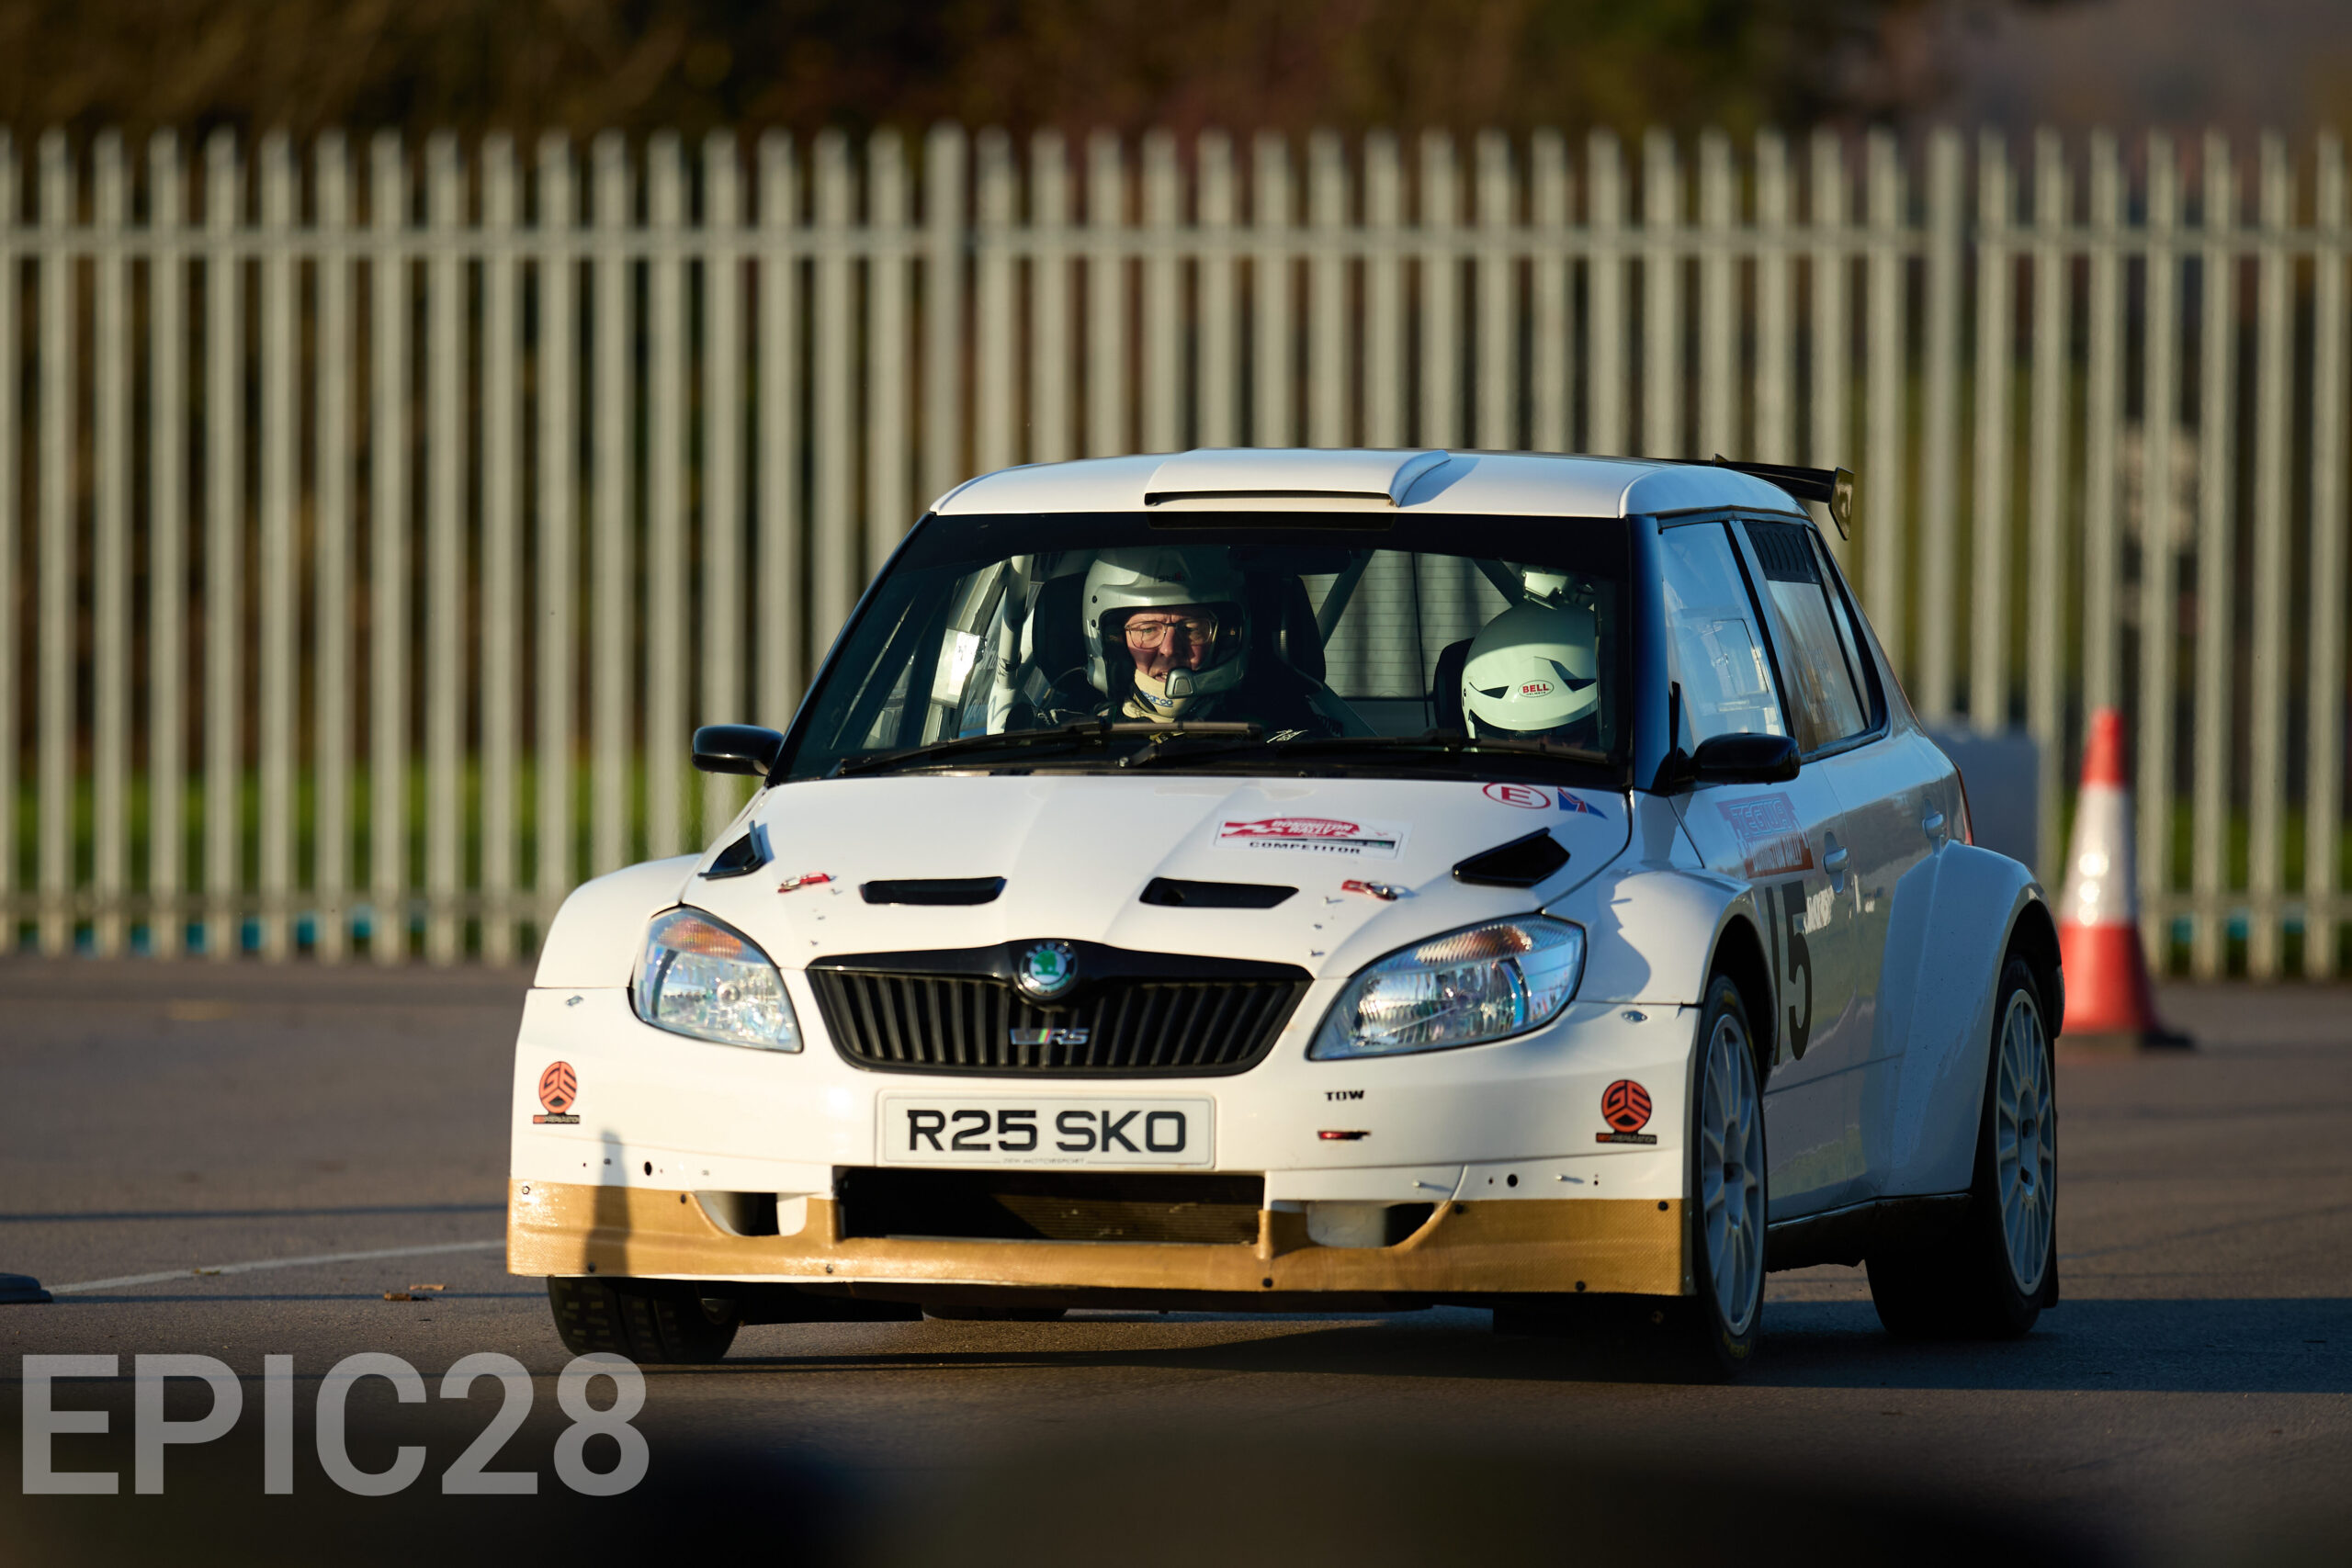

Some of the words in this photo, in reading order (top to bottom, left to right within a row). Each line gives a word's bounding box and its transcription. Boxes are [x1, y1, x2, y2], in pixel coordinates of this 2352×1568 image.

[1522, 683, 1550, 694] BELL
[1501, 786, 1532, 806] E
[1250, 841, 1361, 854] COMPETITOR
[1325, 1090, 1364, 1101] TOW
[907, 1110, 1038, 1151] R25
[1056, 1111, 1186, 1153] SKO
